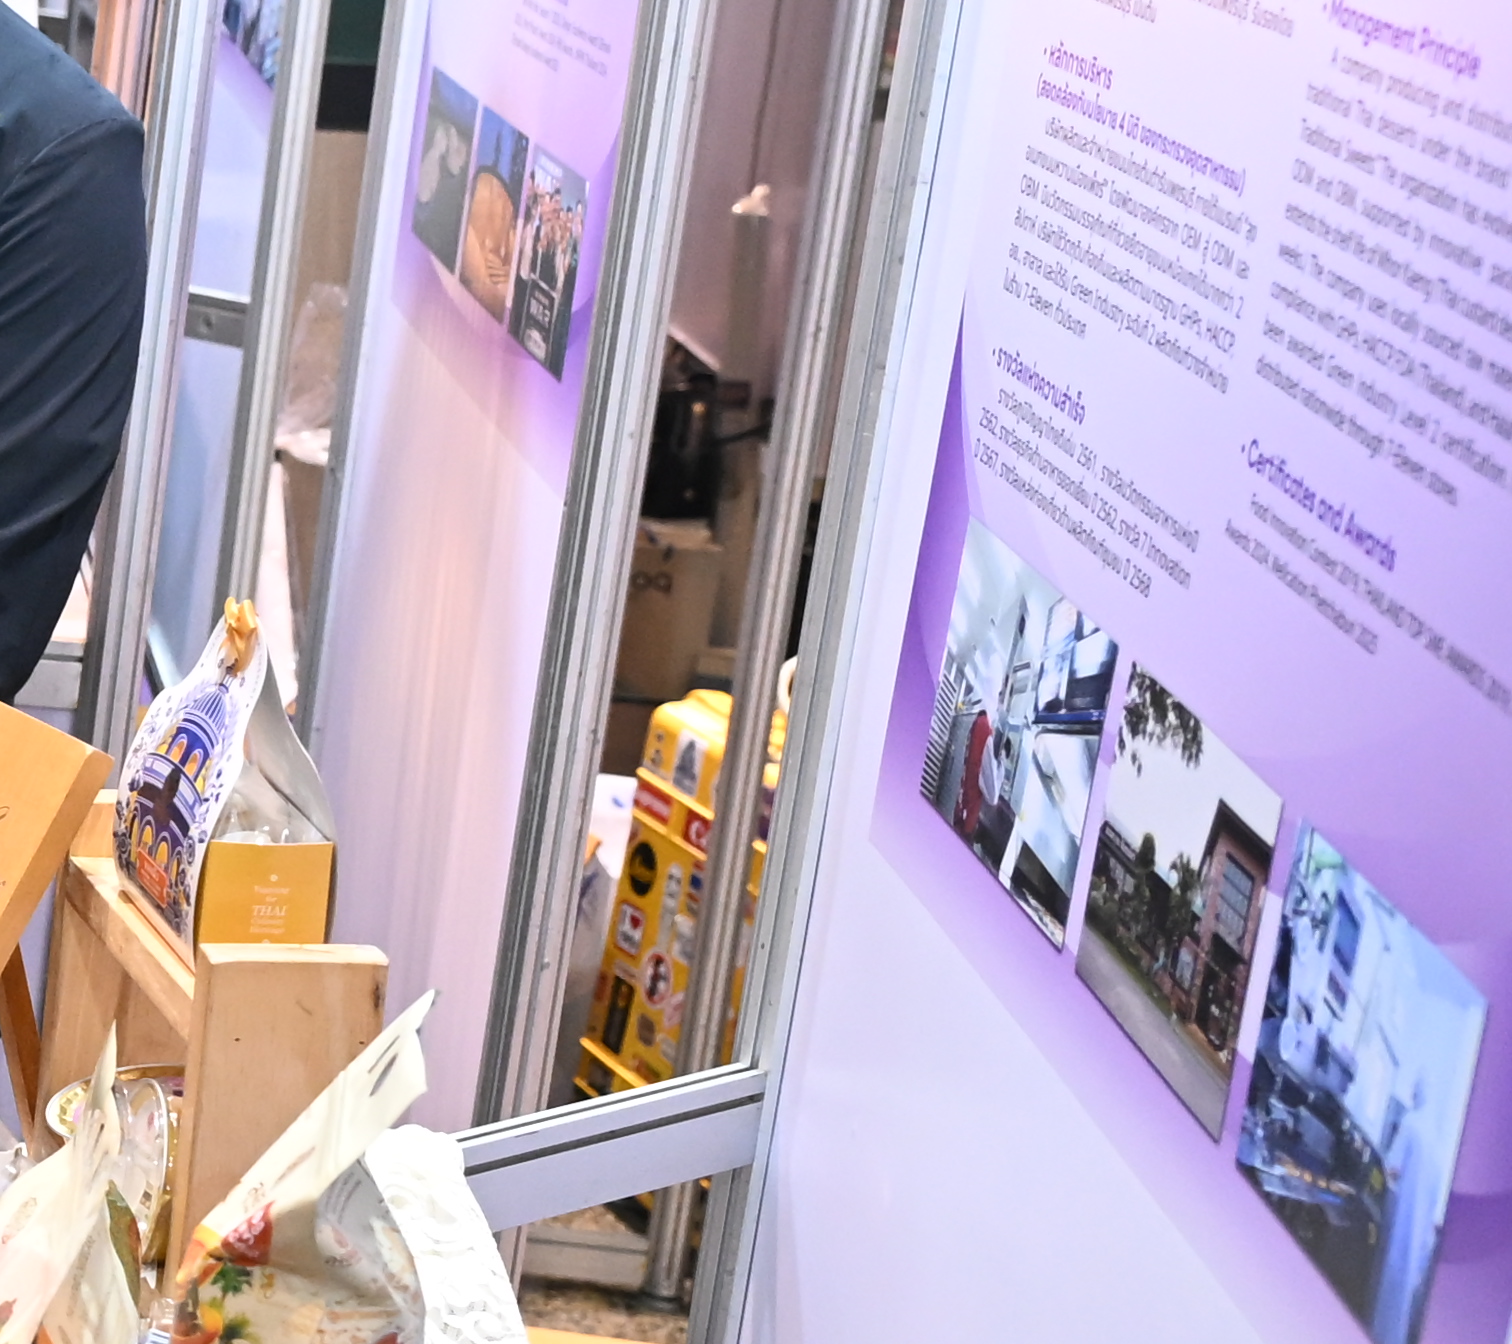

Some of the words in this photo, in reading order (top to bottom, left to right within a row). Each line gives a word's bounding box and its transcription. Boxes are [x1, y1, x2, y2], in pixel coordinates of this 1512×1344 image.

[1048, 40, 1112, 89] หลักการบริหาร
[1339, 55, 1385, 92] company
[1418, 26, 1481, 79] Principle
[1117, 111, 1126, 133] 4
[1019, 173, 1040, 199] OBM
[1234, 295, 1244, 320] 2
[1180, 222, 1202, 251] OEM
[1210, 239, 1235, 270] ODM
[1022, 281, 1053, 317] 7-Eleven
[1069, 274, 1093, 304] Green
[1092, 288, 1126, 332] Industry
[996, 347, 1085, 424] รางวัลแห่งความสำเร็จ
[1076, 442, 1097, 478] 2561,
[978, 406, 998, 437] 2562,
[1139, 530, 1149, 552] 7
[1145, 536, 1191, 589] Innovation
[979, 442, 999, 475] 2567,
[1128, 564, 1152, 598] 2568
[1247, 438, 1316, 512] Certificates
[1316, 497, 1345, 533] and
[1343, 511, 1396, 571] Awards
[251, 904, 287, 916] THAI
